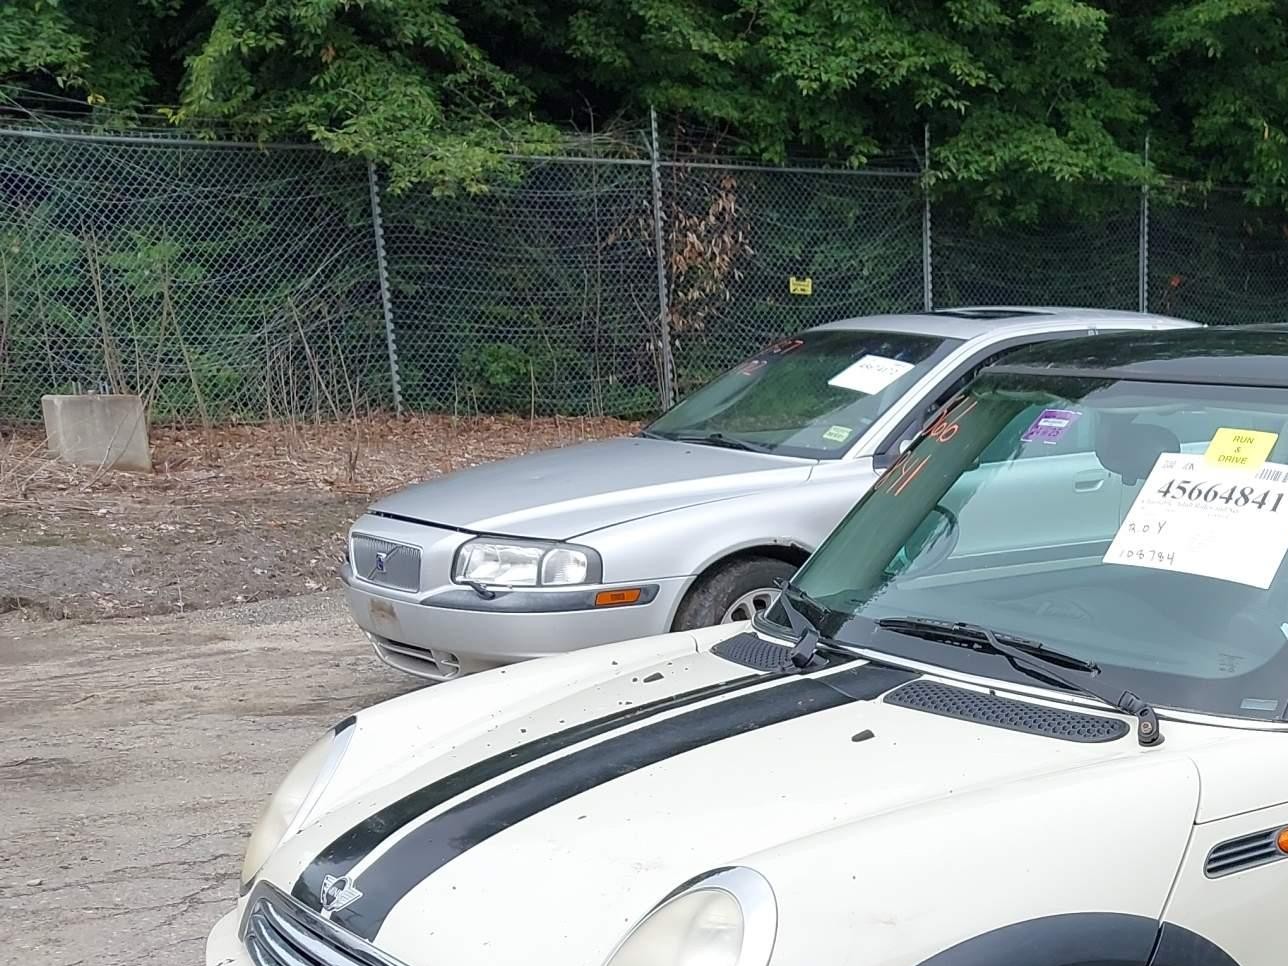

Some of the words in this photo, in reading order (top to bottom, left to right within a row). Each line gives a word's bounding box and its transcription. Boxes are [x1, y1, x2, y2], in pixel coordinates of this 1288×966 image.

[1232, 435, 1255, 445] RUN
[1217, 454, 1248, 465] DRIVE
[1157, 479, 1285, 513] 45664841
